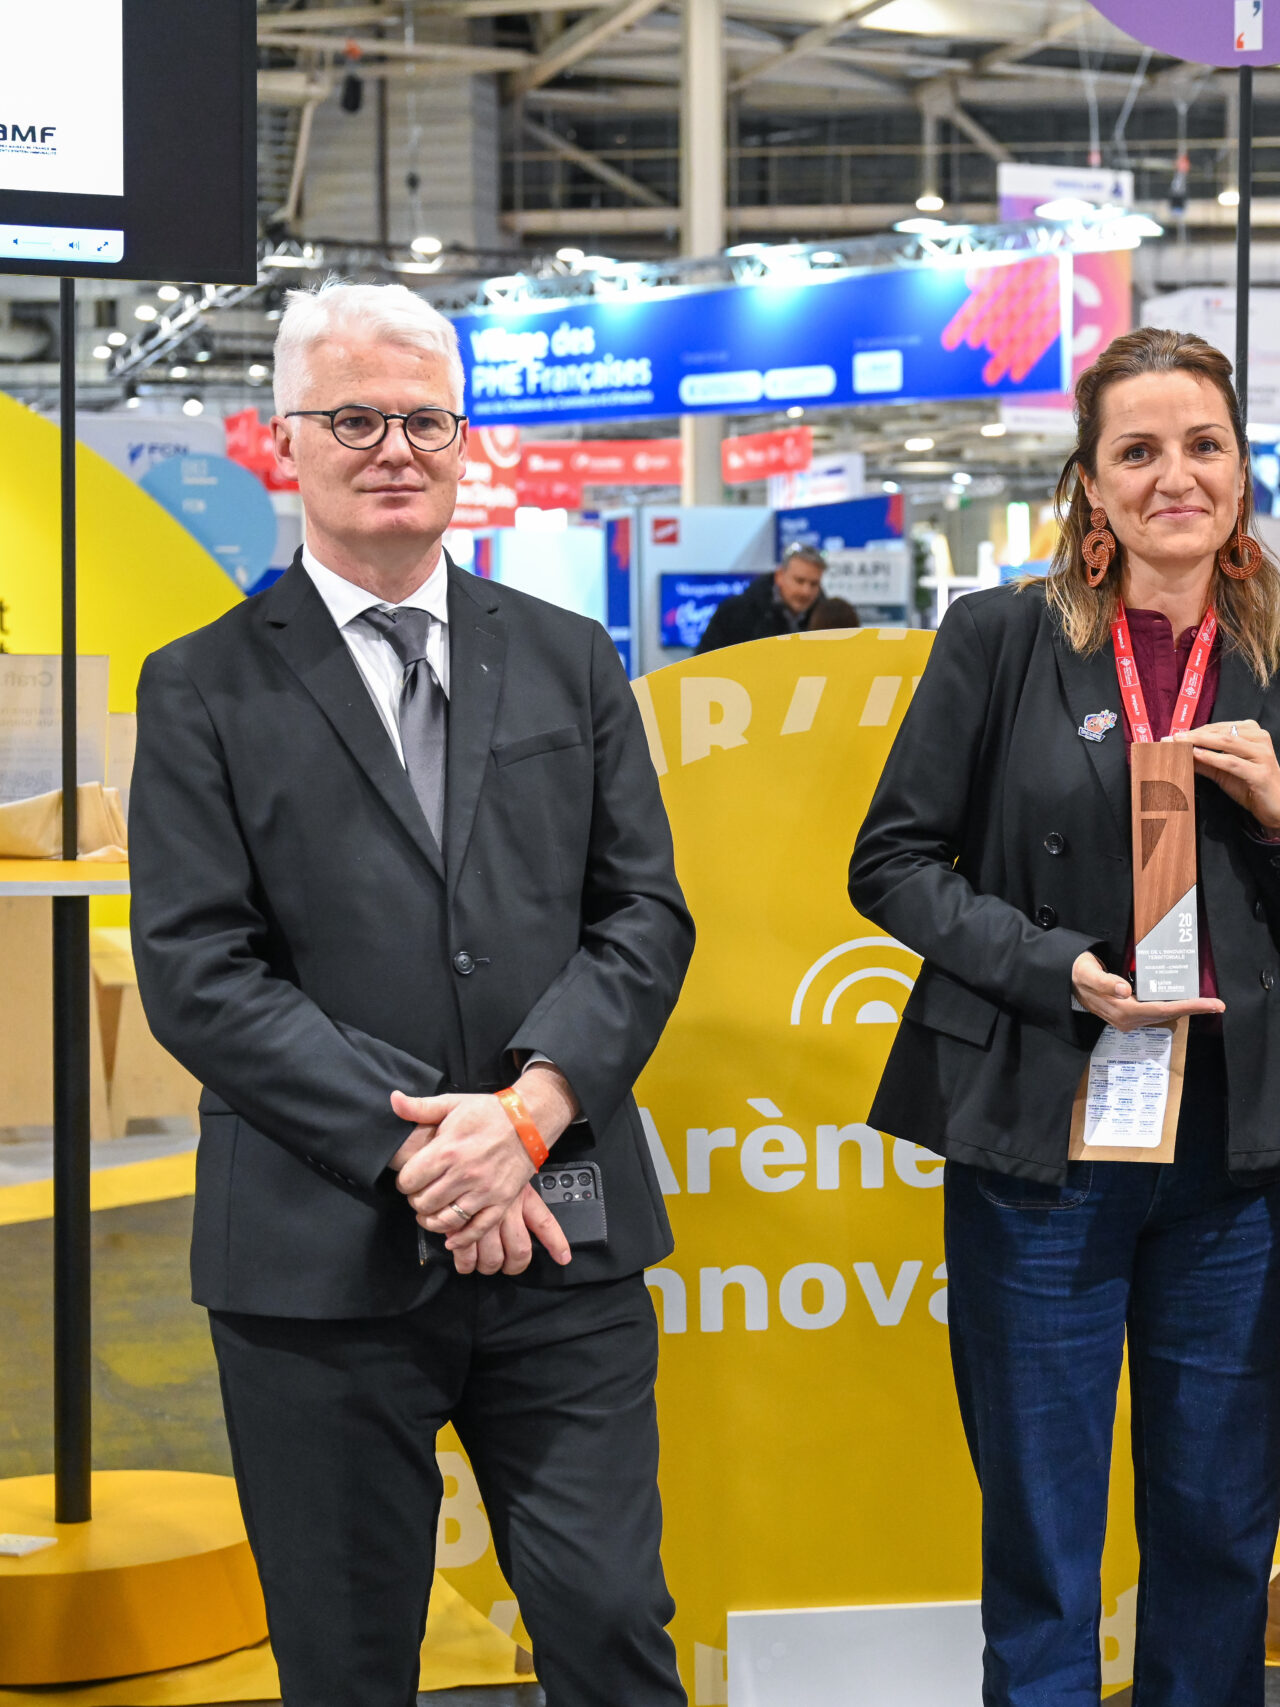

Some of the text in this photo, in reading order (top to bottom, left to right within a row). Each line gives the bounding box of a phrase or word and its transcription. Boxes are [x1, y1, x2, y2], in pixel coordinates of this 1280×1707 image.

[551, 321, 596, 357] des
[526, 352, 652, 395] Françaises
[1178, 912, 1192, 928] 20
[1179, 928, 1193, 943] 25
